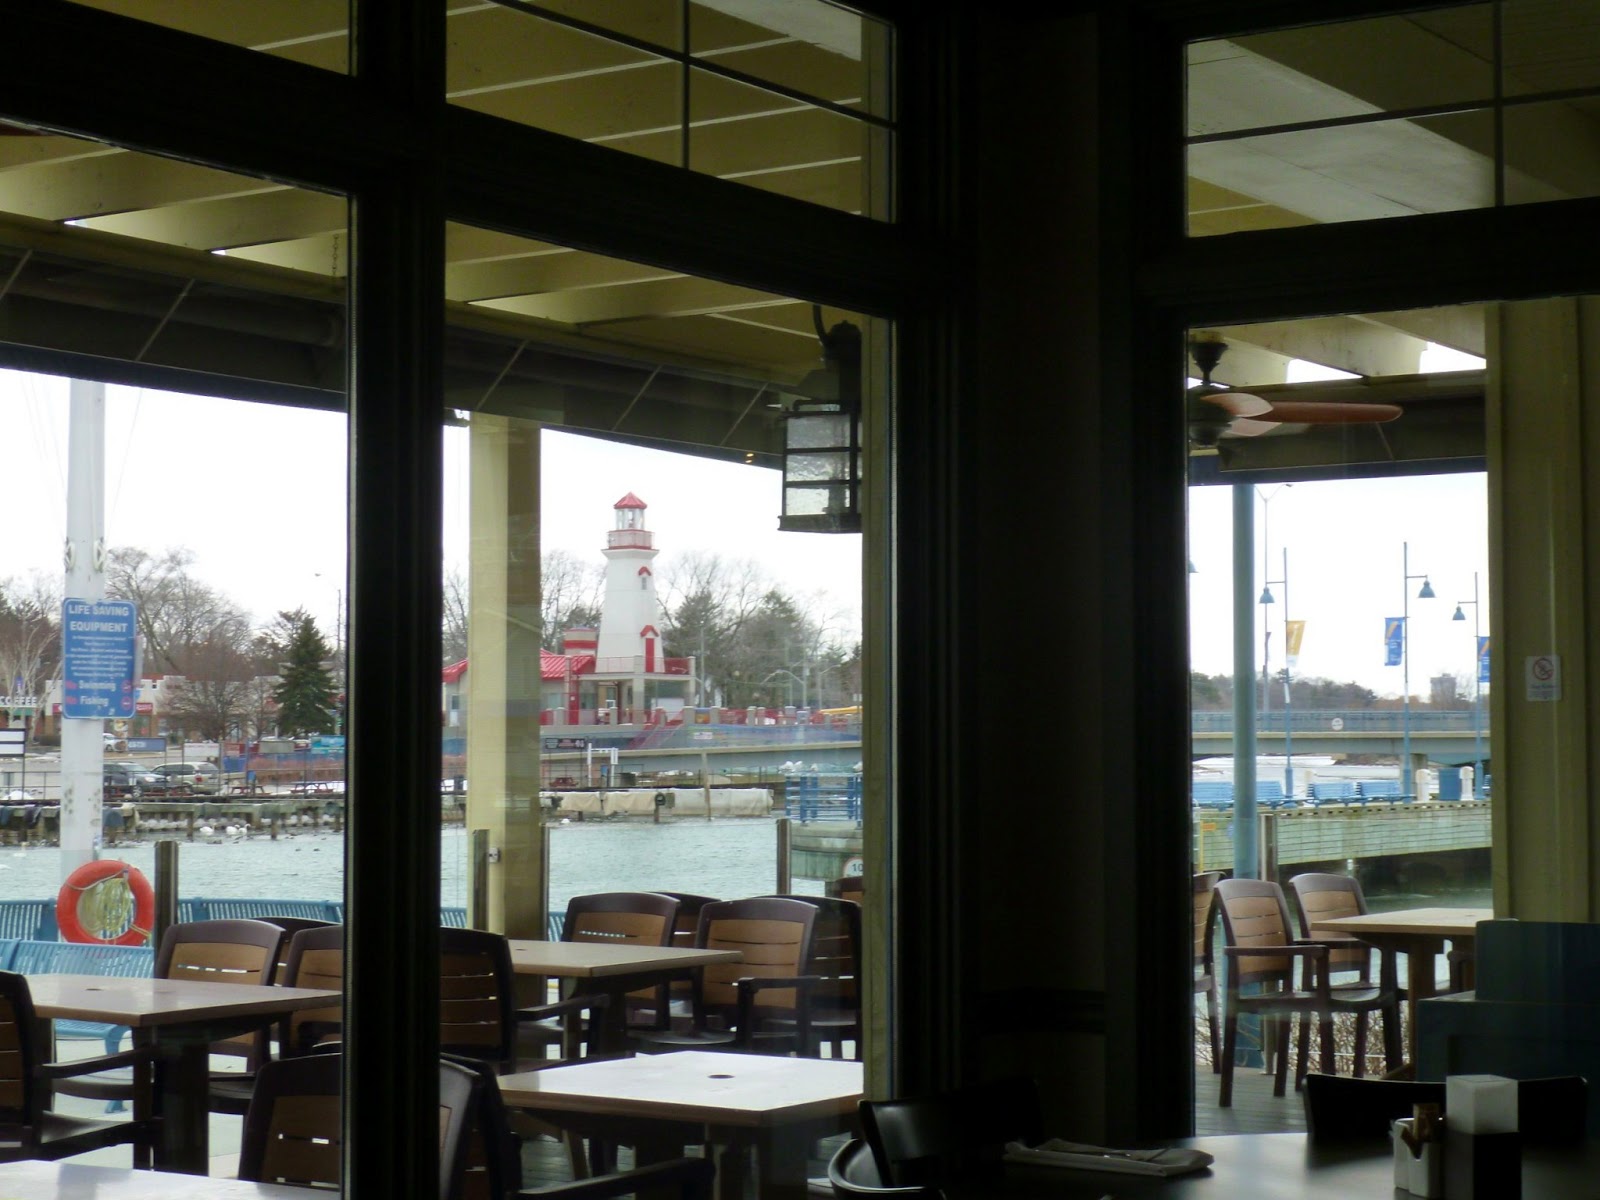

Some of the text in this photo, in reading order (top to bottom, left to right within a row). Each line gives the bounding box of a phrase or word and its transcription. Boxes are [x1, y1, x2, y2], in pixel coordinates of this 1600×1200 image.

[68, 604, 129, 616] LIFE SAVING
[70, 621, 128, 632] EQUIPMENT
[79, 680, 116, 692] Swimming
[80, 695, 109, 707] Fishing
